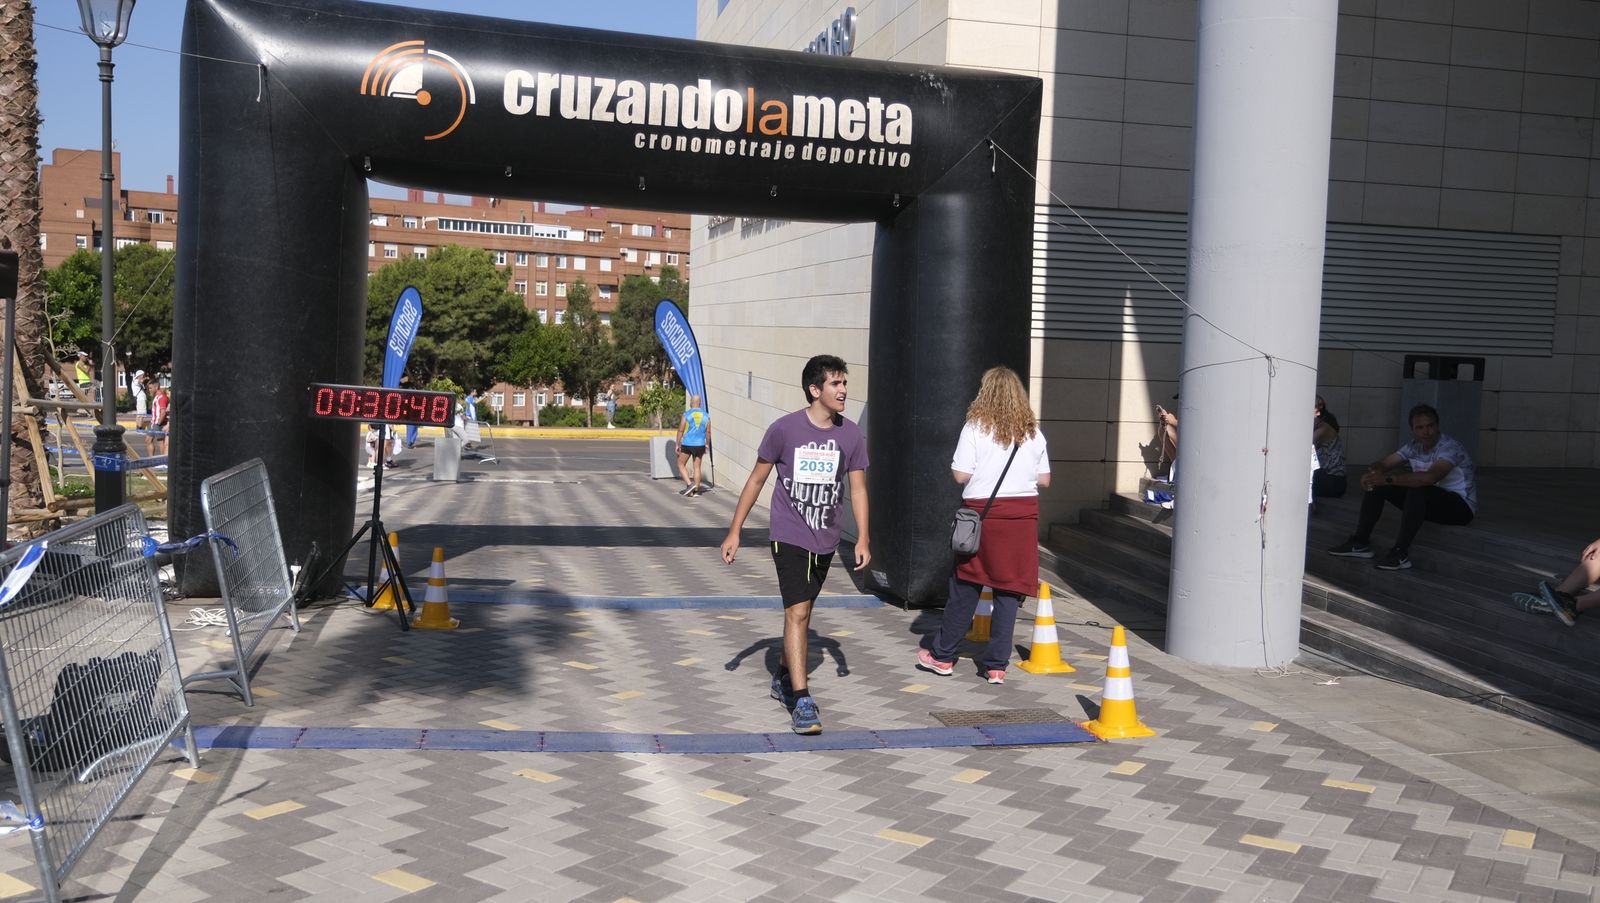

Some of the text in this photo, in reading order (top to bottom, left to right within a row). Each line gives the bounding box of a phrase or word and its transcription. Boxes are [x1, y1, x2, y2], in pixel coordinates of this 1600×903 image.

[634, 132, 911, 168] cronometraje deportivo
[799, 460, 834, 473] 2033
